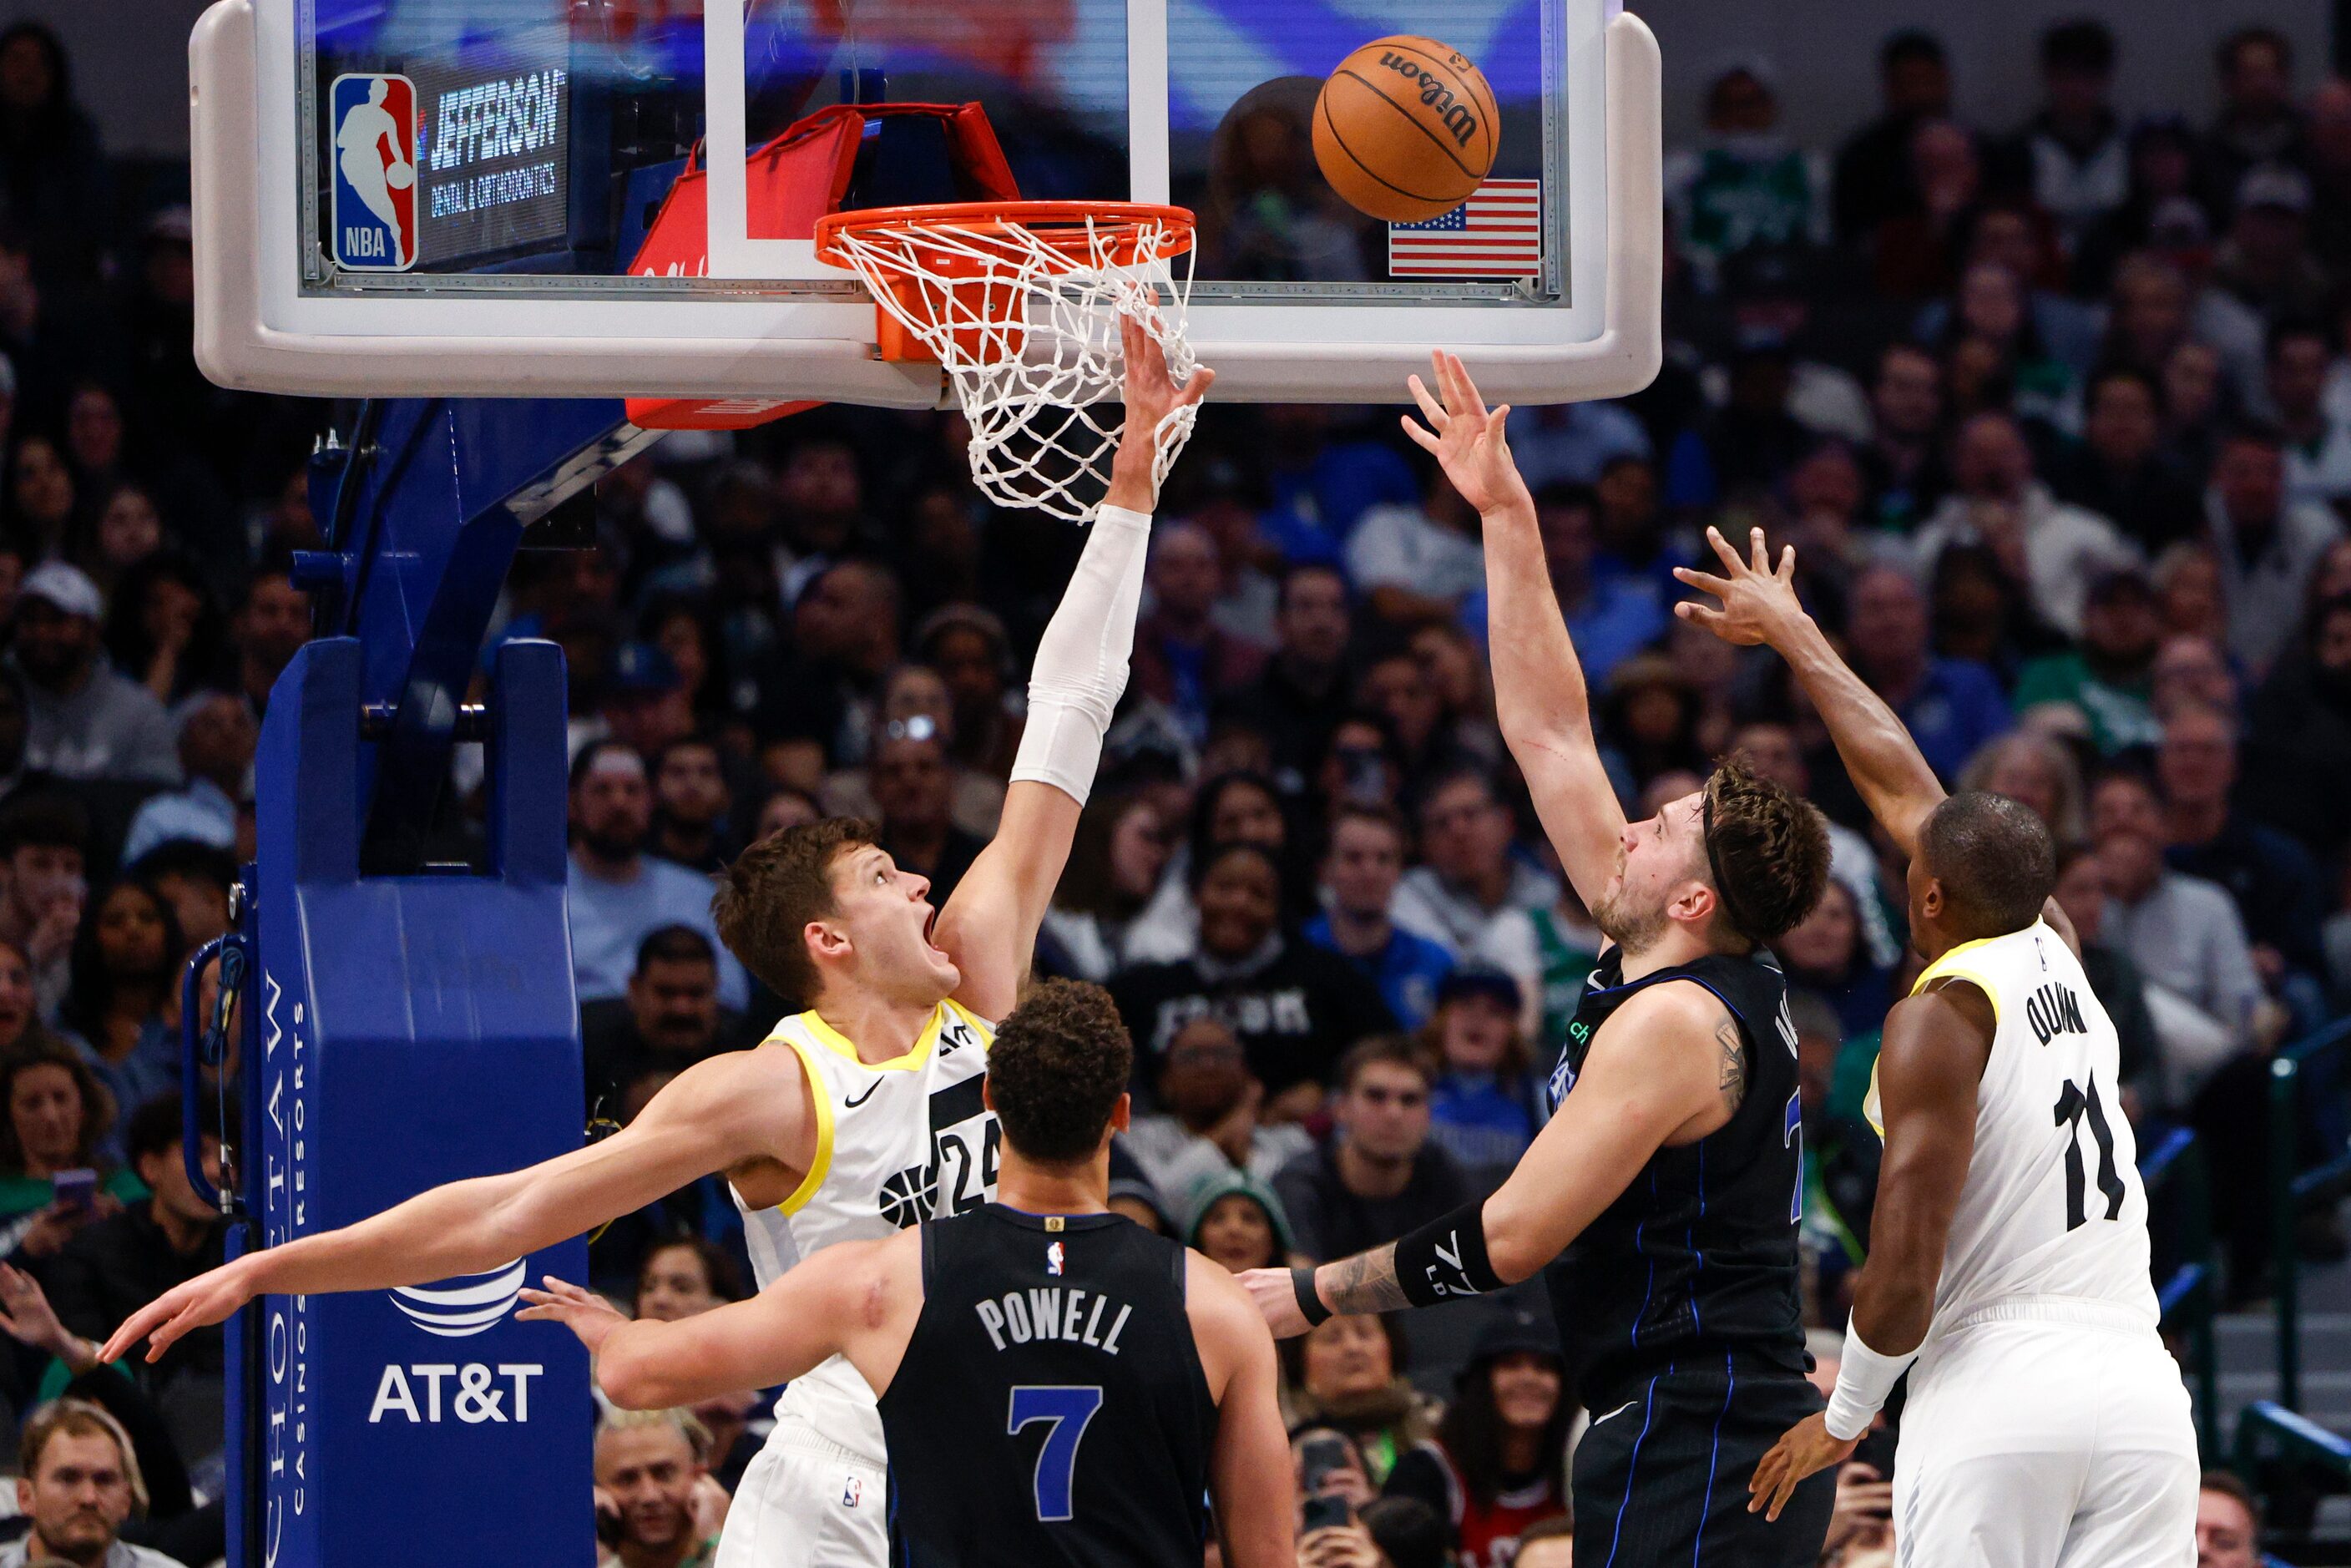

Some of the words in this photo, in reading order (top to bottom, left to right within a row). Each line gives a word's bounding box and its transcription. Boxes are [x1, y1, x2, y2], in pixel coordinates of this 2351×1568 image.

[431, 68, 559, 171] JEFFERSON
[1379, 51, 1478, 148] Wilson
[431, 180, 468, 218] DENTAL
[477, 162, 555, 209] ORTHODONTICS
[345, 226, 386, 257] NBA
[294, 1001, 305, 1227] RESORTS
[2054, 1066, 2126, 1232] 11
[939, 1117, 1001, 1214] 24
[974, 1287, 1134, 1356] POWELL
[368, 1362, 544, 1424] AT&T
[1007, 1385, 1104, 1523] 7
